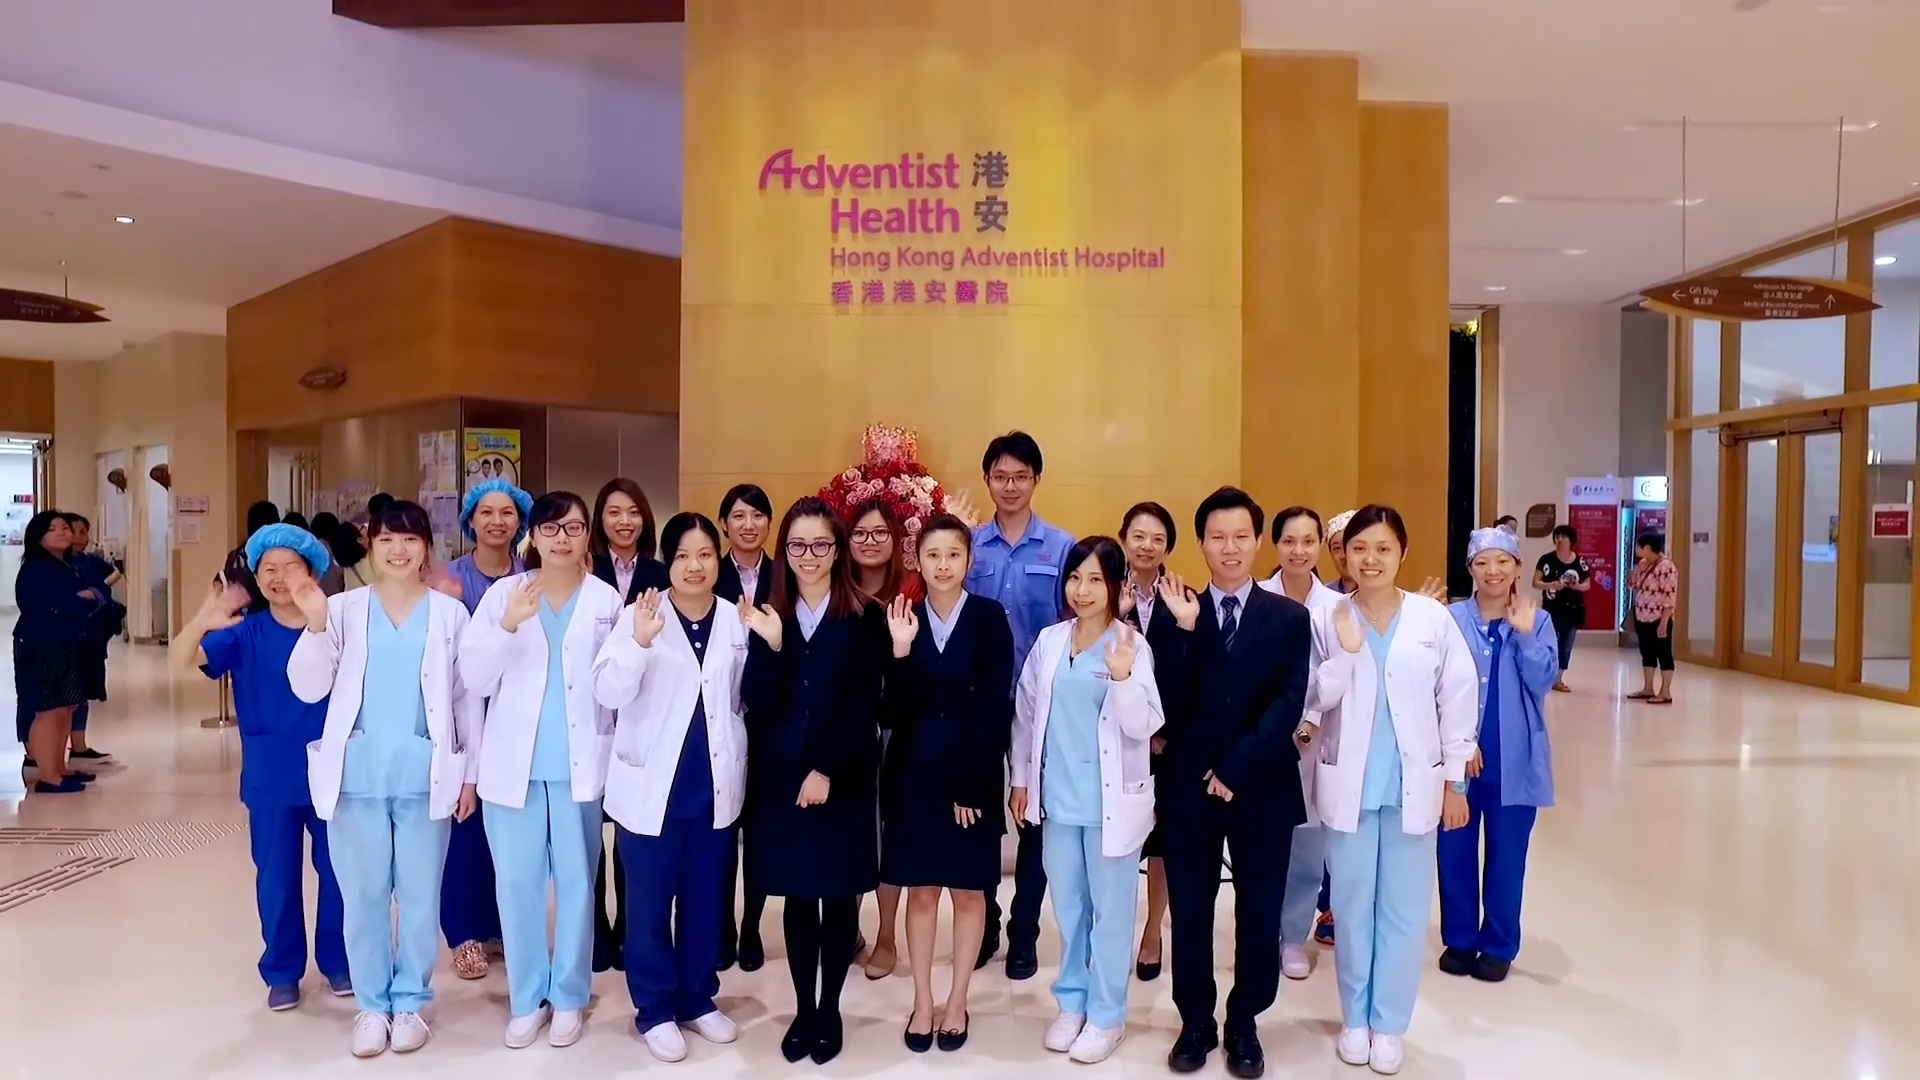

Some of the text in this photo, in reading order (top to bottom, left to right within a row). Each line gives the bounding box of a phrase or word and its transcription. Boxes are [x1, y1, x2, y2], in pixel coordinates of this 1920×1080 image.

[758, 148, 960, 190] Adventist
[830, 197, 960, 234] Health
[830, 245, 1165, 273] Hong Kong Adventist Hospital
[830, 279, 1010, 305] 香港港安醫院
[1702, 286, 1719, 298] Shop
